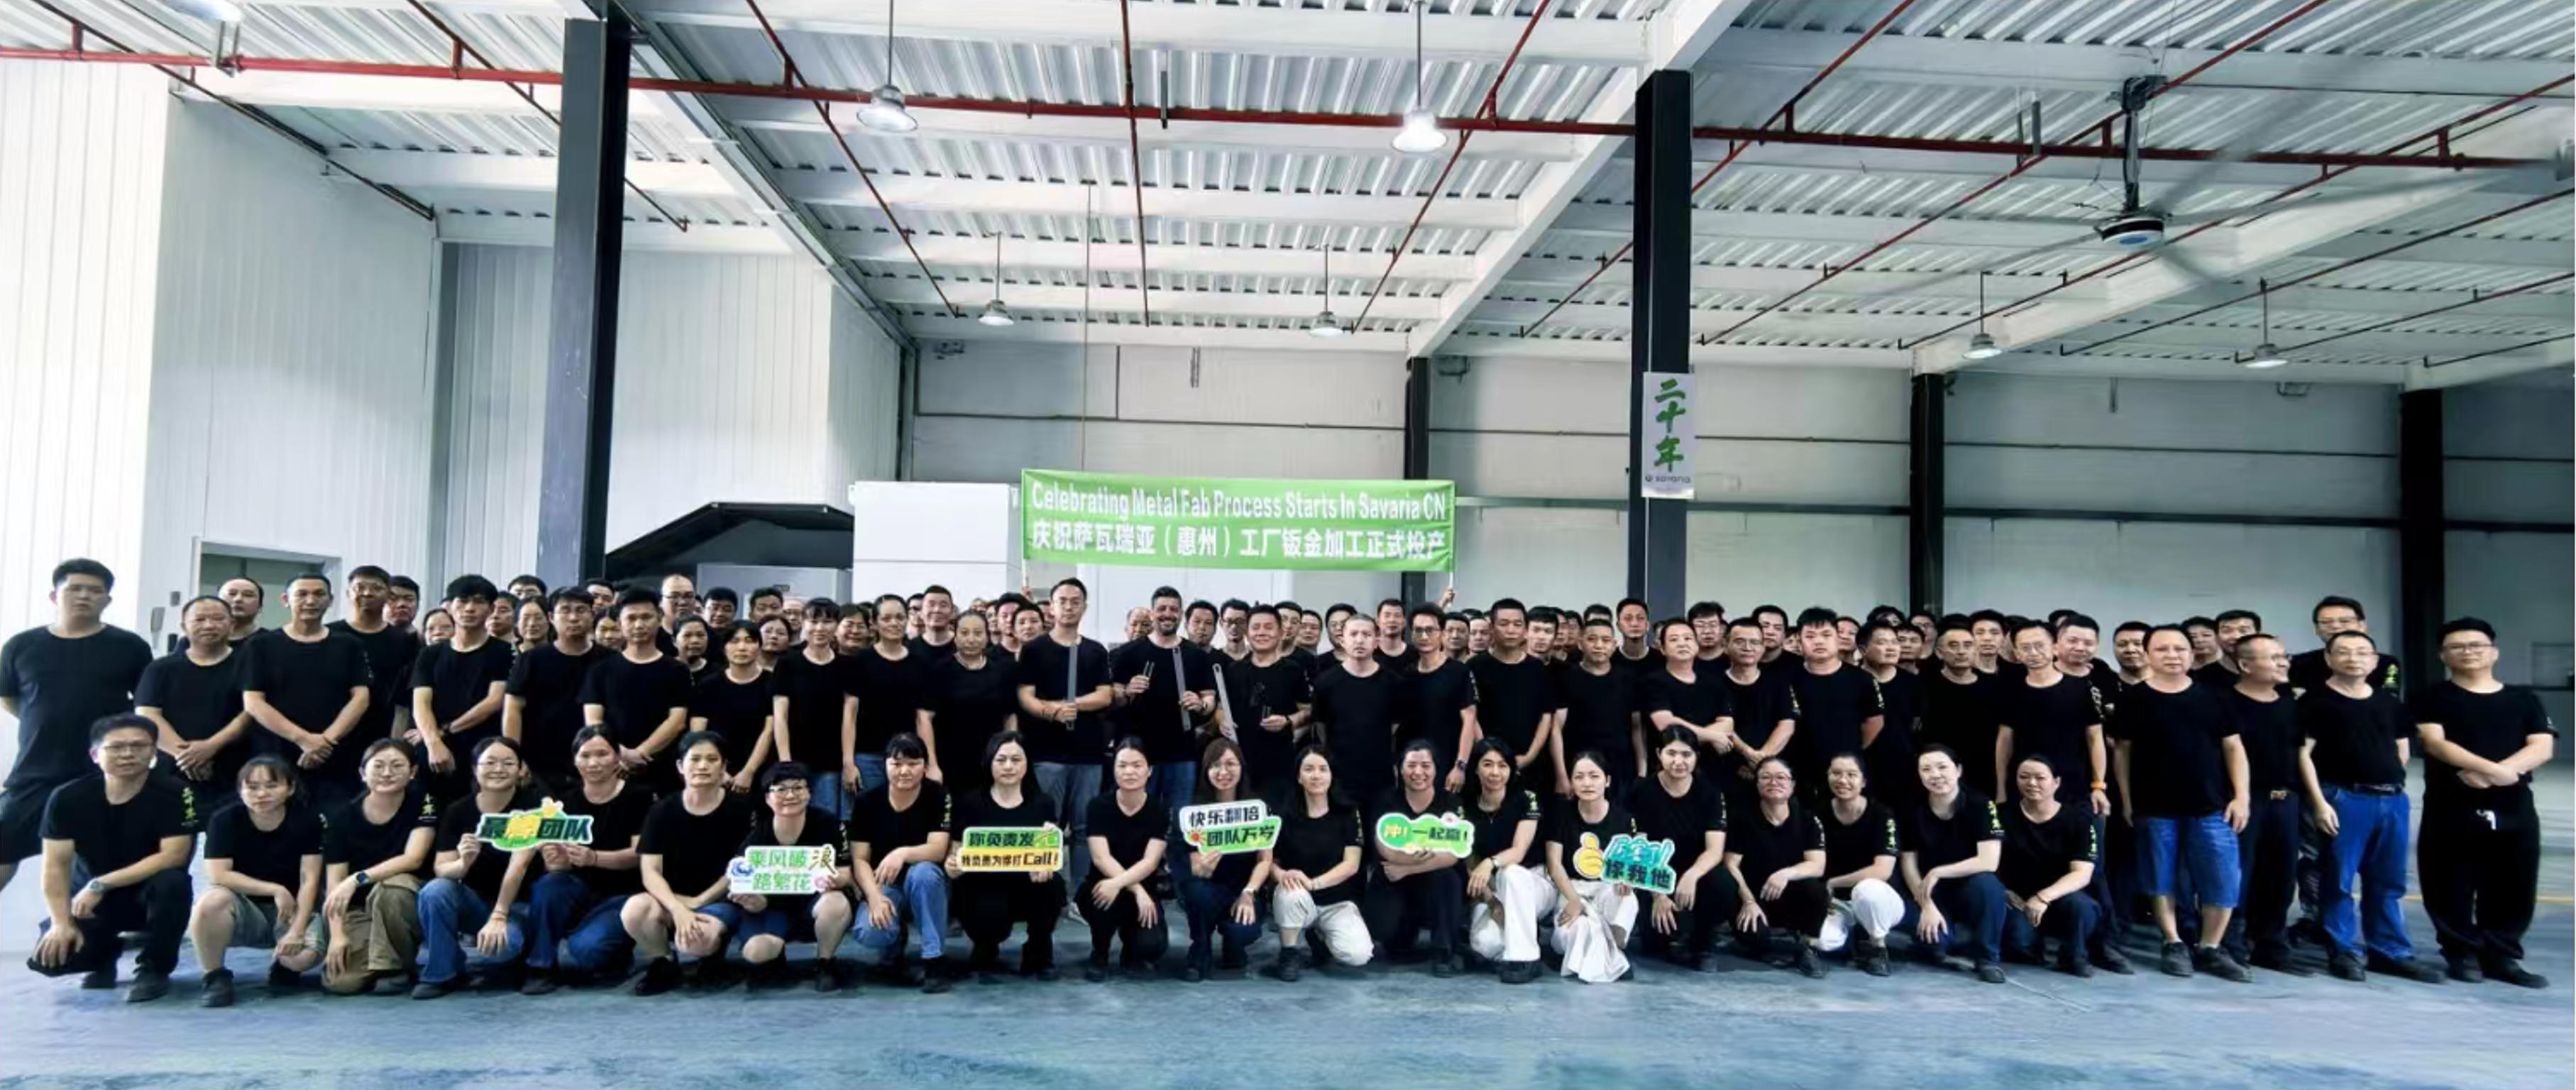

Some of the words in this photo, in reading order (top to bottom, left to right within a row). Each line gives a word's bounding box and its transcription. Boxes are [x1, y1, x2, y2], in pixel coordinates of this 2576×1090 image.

[1654, 378, 1686, 473] 二十年
[1033, 482, 1129, 520] Celebrating
[1133, 488, 1178, 517] Metal
[1182, 488, 1210, 517] Fab
[1213, 490, 1282, 518] Process
[1285, 490, 1337, 519] Starts
[1341, 491, 1355, 519] In
[1359, 491, 1420, 519] Savaria
[1424, 492, 1446, 519] CN
[1189, 806, 1260, 827] 快乐翻倍
[1207, 825, 1275, 846] 团队万岁
